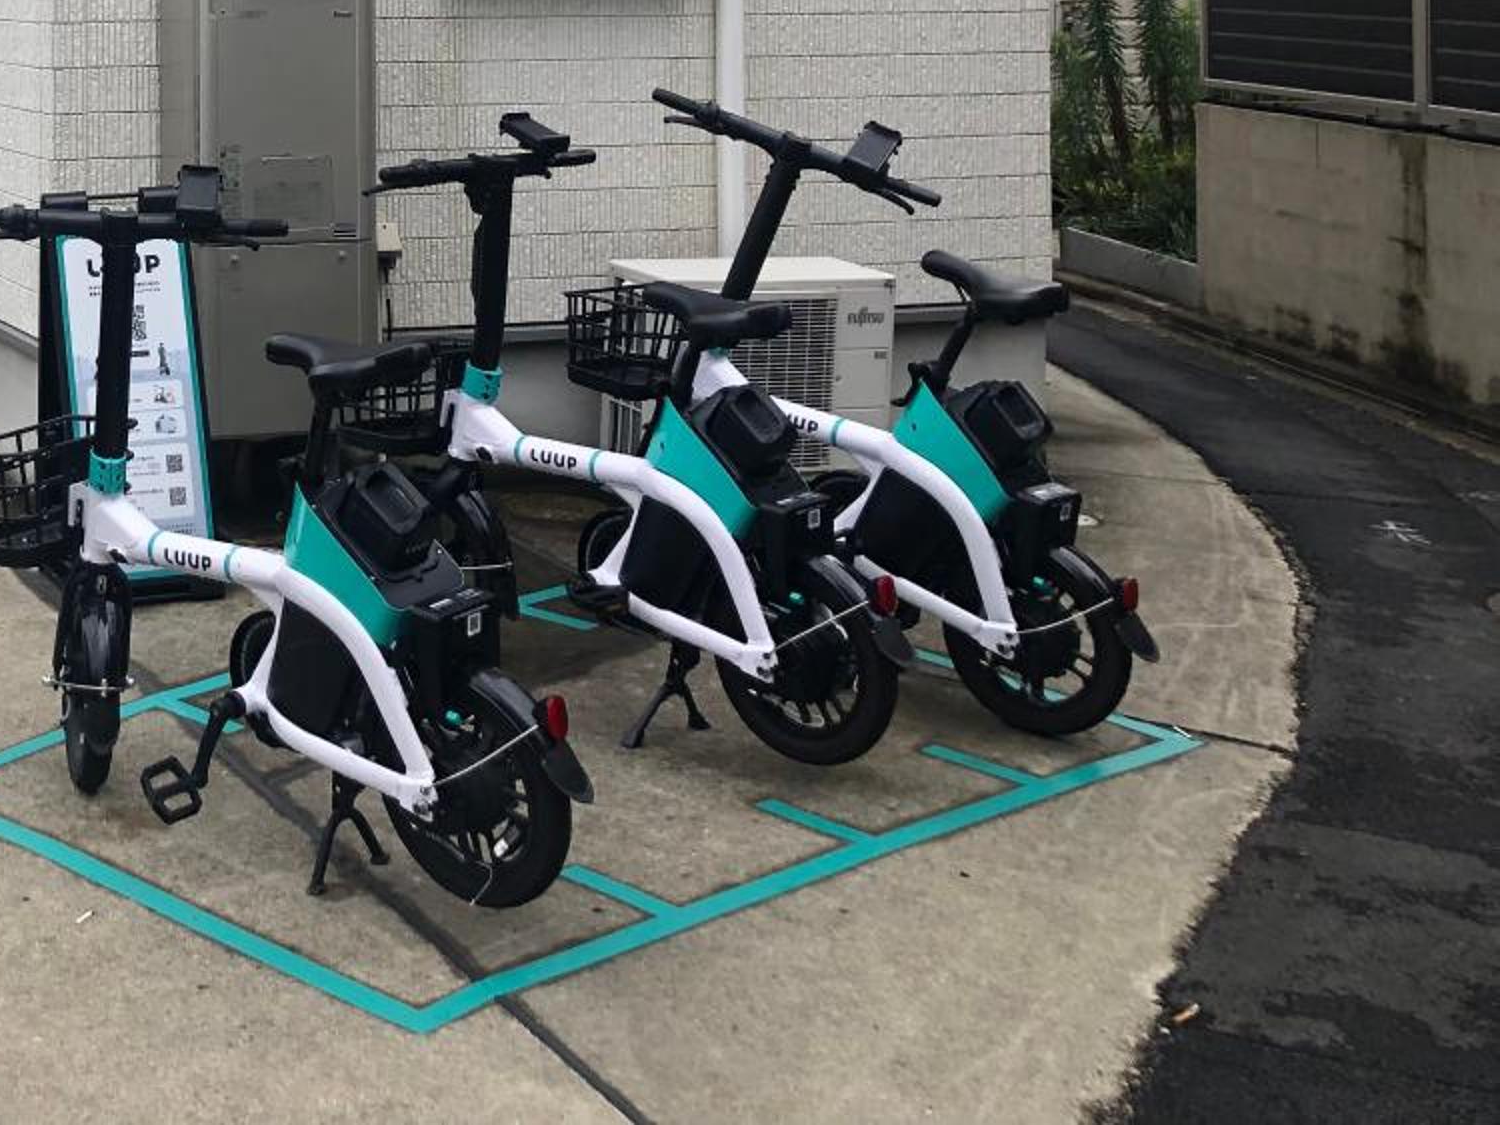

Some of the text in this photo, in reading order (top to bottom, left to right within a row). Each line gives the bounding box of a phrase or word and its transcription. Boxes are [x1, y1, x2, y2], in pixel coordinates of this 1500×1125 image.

[87, 254, 160, 277] LP
[530, 448, 577, 470] LUUP
[164, 548, 211, 571] LUUP
